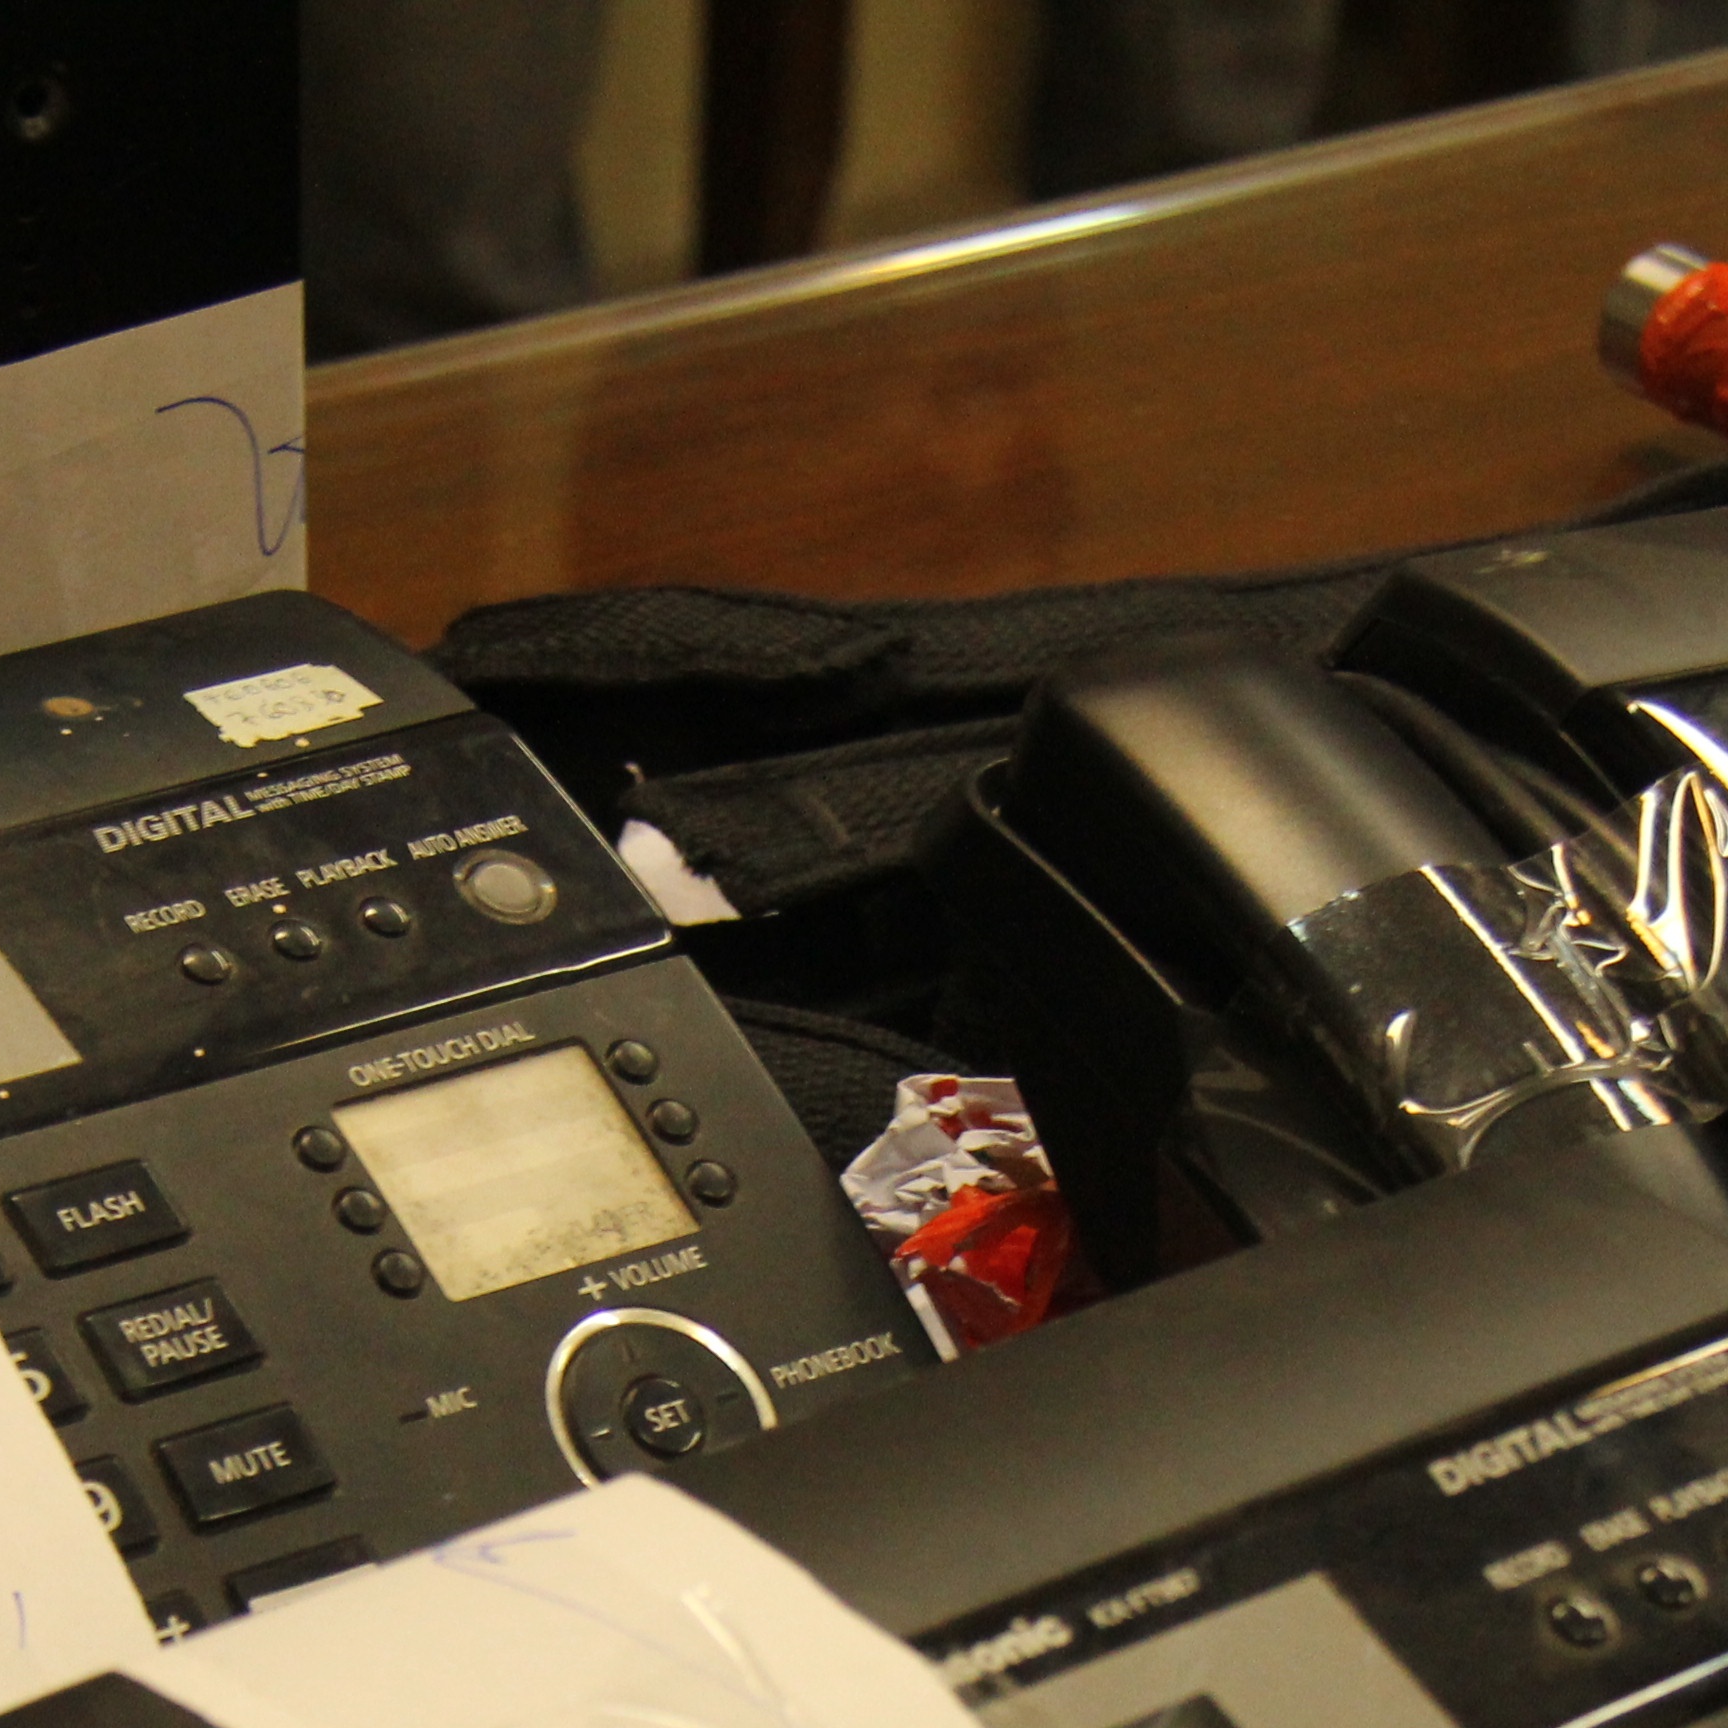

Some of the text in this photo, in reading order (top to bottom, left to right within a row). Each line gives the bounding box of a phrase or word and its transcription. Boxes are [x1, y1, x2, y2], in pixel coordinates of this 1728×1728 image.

[338, 753, 405, 778] SYSTEM
[359, 764, 412, 787] STAMP
[92, 793, 256, 853] DIGITAL
[408, 814, 529, 860] AUTO ANSWER
[296, 849, 398, 889] PLAYBACK
[223, 876, 290, 908] ERASE
[124, 900, 207, 933] RECORD
[347, 1020, 537, 1088] ONE-TOUCH DIAL
[56, 1190, 146, 1232] FLASH
[608, 1245, 709, 1292] VOLUME
[117, 1298, 214, 1344] REDIAL/
[140, 1325, 230, 1368] PAUSE
[769, 1330, 904, 1390] PHONEBOOK
[423, 1386, 478, 1421] MIC
[644, 1398, 690, 1434] SET
[208, 1441, 292, 1486] MUTE
[1427, 1410, 1594, 1497] DIGITAL
